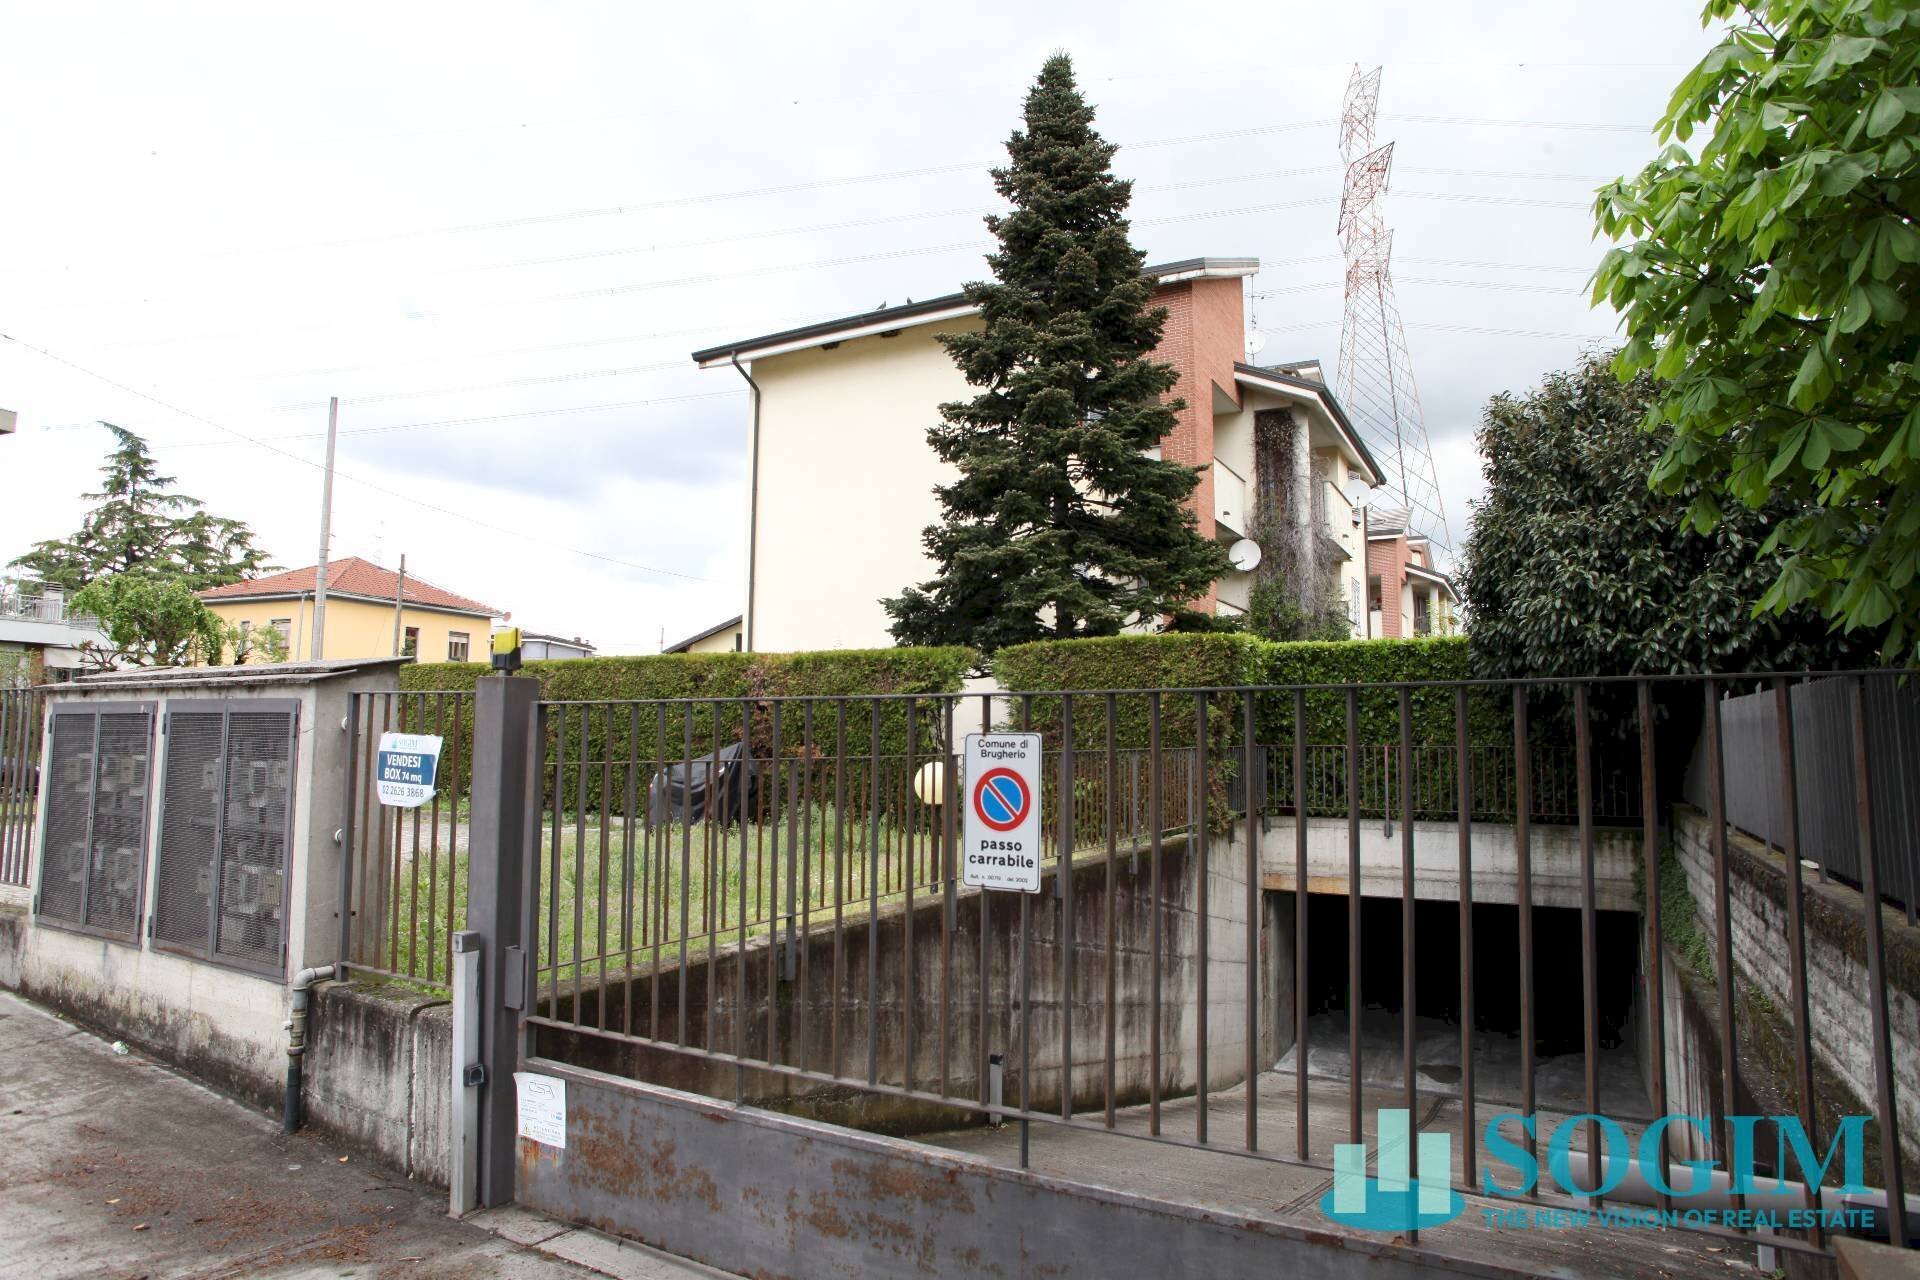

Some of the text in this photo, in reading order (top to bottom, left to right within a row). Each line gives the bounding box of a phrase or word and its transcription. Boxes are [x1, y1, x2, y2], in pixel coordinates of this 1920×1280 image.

[978, 739, 1029, 749] Comune di
[387, 754, 421, 768] VENDESI
[980, 749, 1026, 760] Brugherio
[385, 768, 421, 784] BOX 74 mq
[980, 839, 1023, 852] passo
[969, 853, 1034, 868] carrabile
